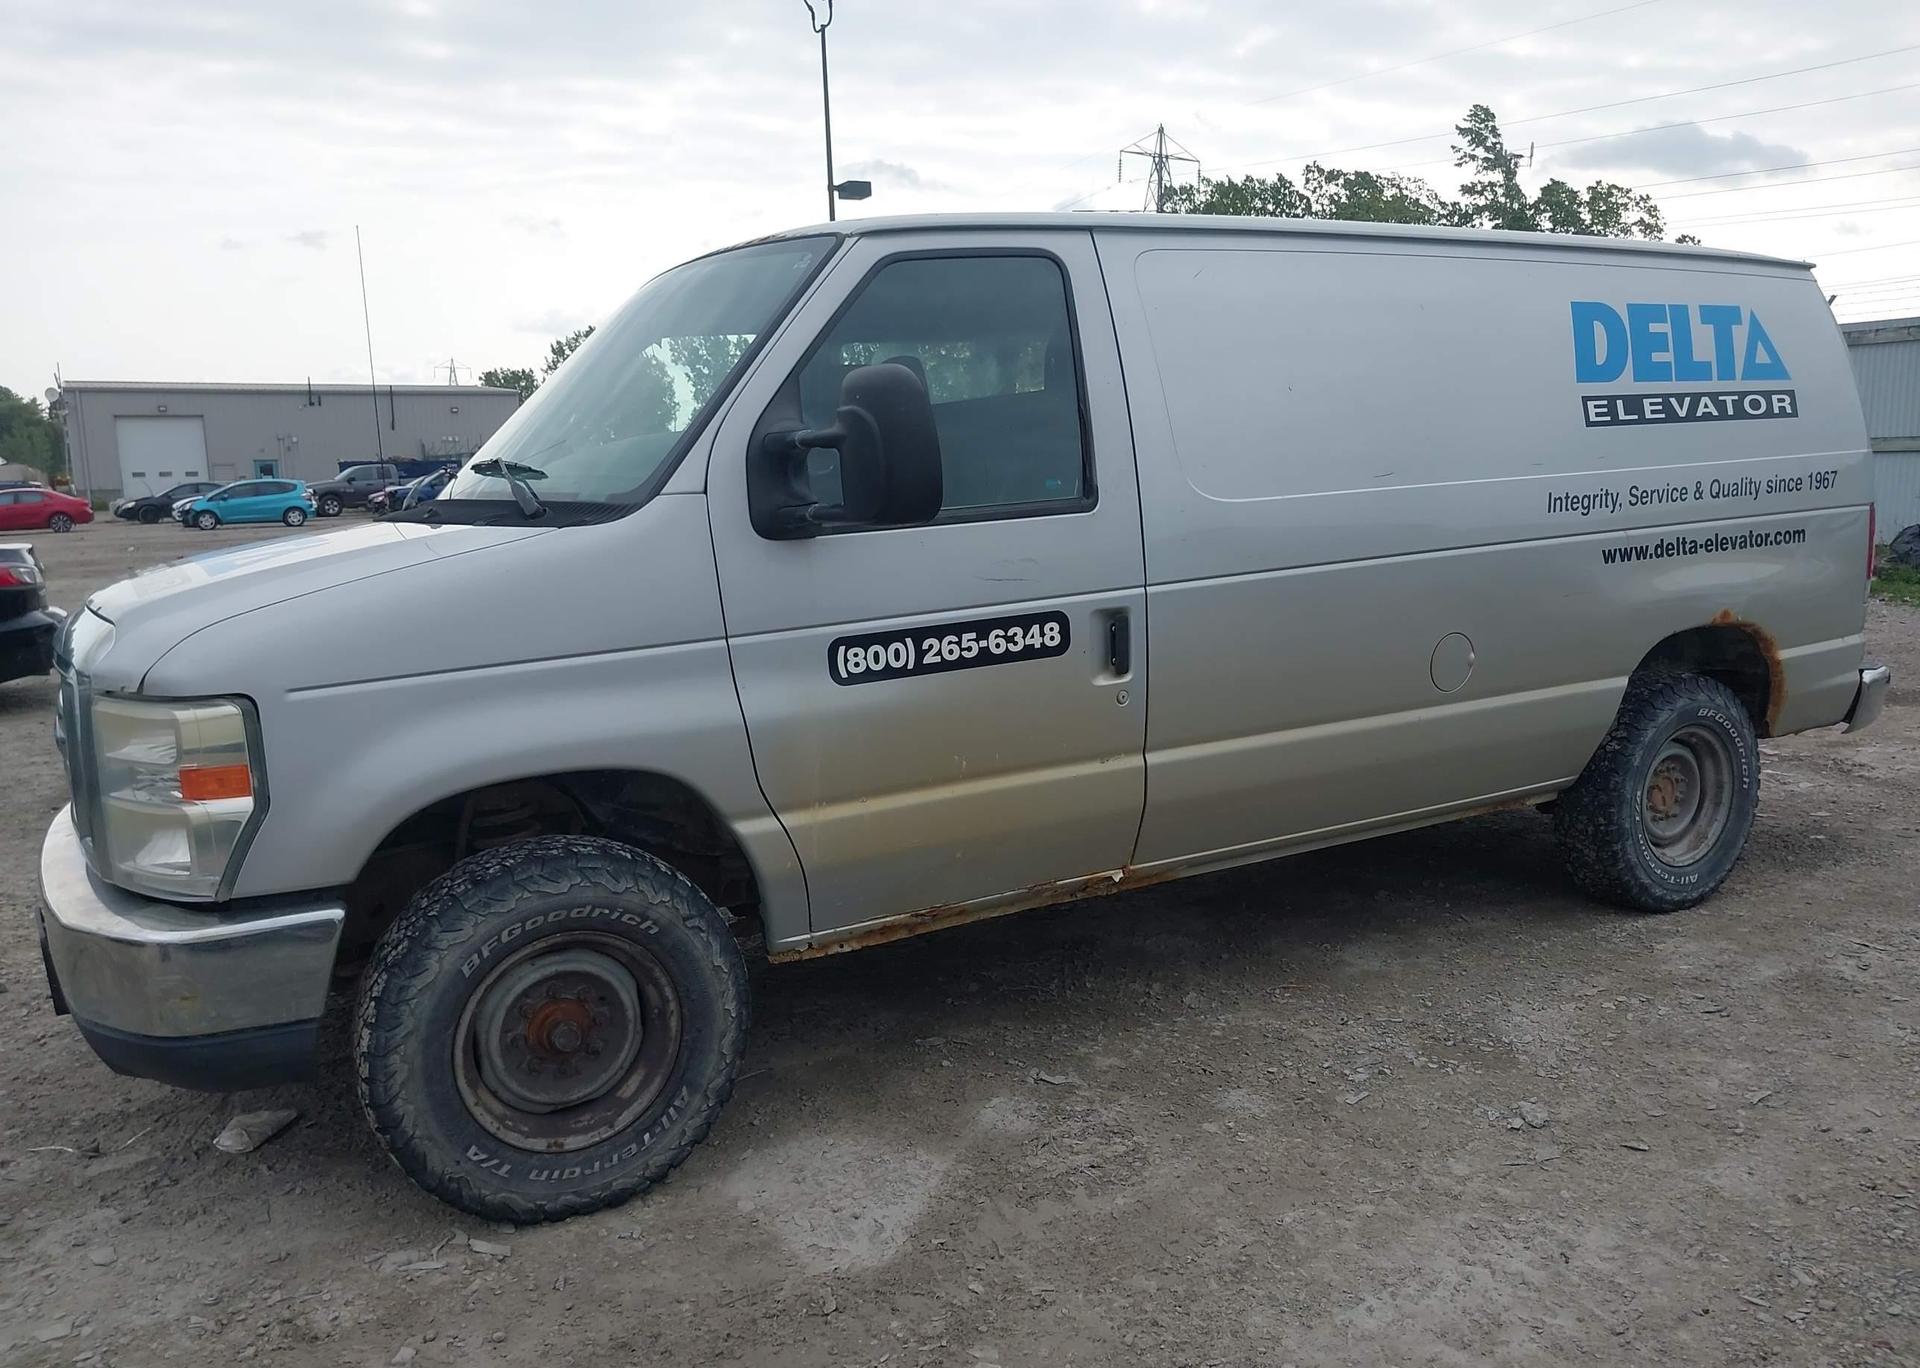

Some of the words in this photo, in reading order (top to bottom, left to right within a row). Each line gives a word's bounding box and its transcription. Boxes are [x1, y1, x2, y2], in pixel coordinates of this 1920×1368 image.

[1570, 301, 1792, 383] DELTA
[1587, 394, 1793, 422] ELEVATOR
[1547, 490, 1623, 516] Integrity,
[1629, 483, 1688, 507] Service
[1693, 481, 1704, 500] &
[1709, 477, 1761, 501] Quality
[1766, 474, 1803, 494] since
[1807, 470, 1838, 491] 1967
[1602, 526, 1806, 564] www.delta-elevator.com
[837, 637, 916, 678] (800)
[922, 621, 1061, 664] 265-6348
[1698, 707, 1749, 789] BFGoodrich
[460, 903, 660, 979] BFGoodrich
